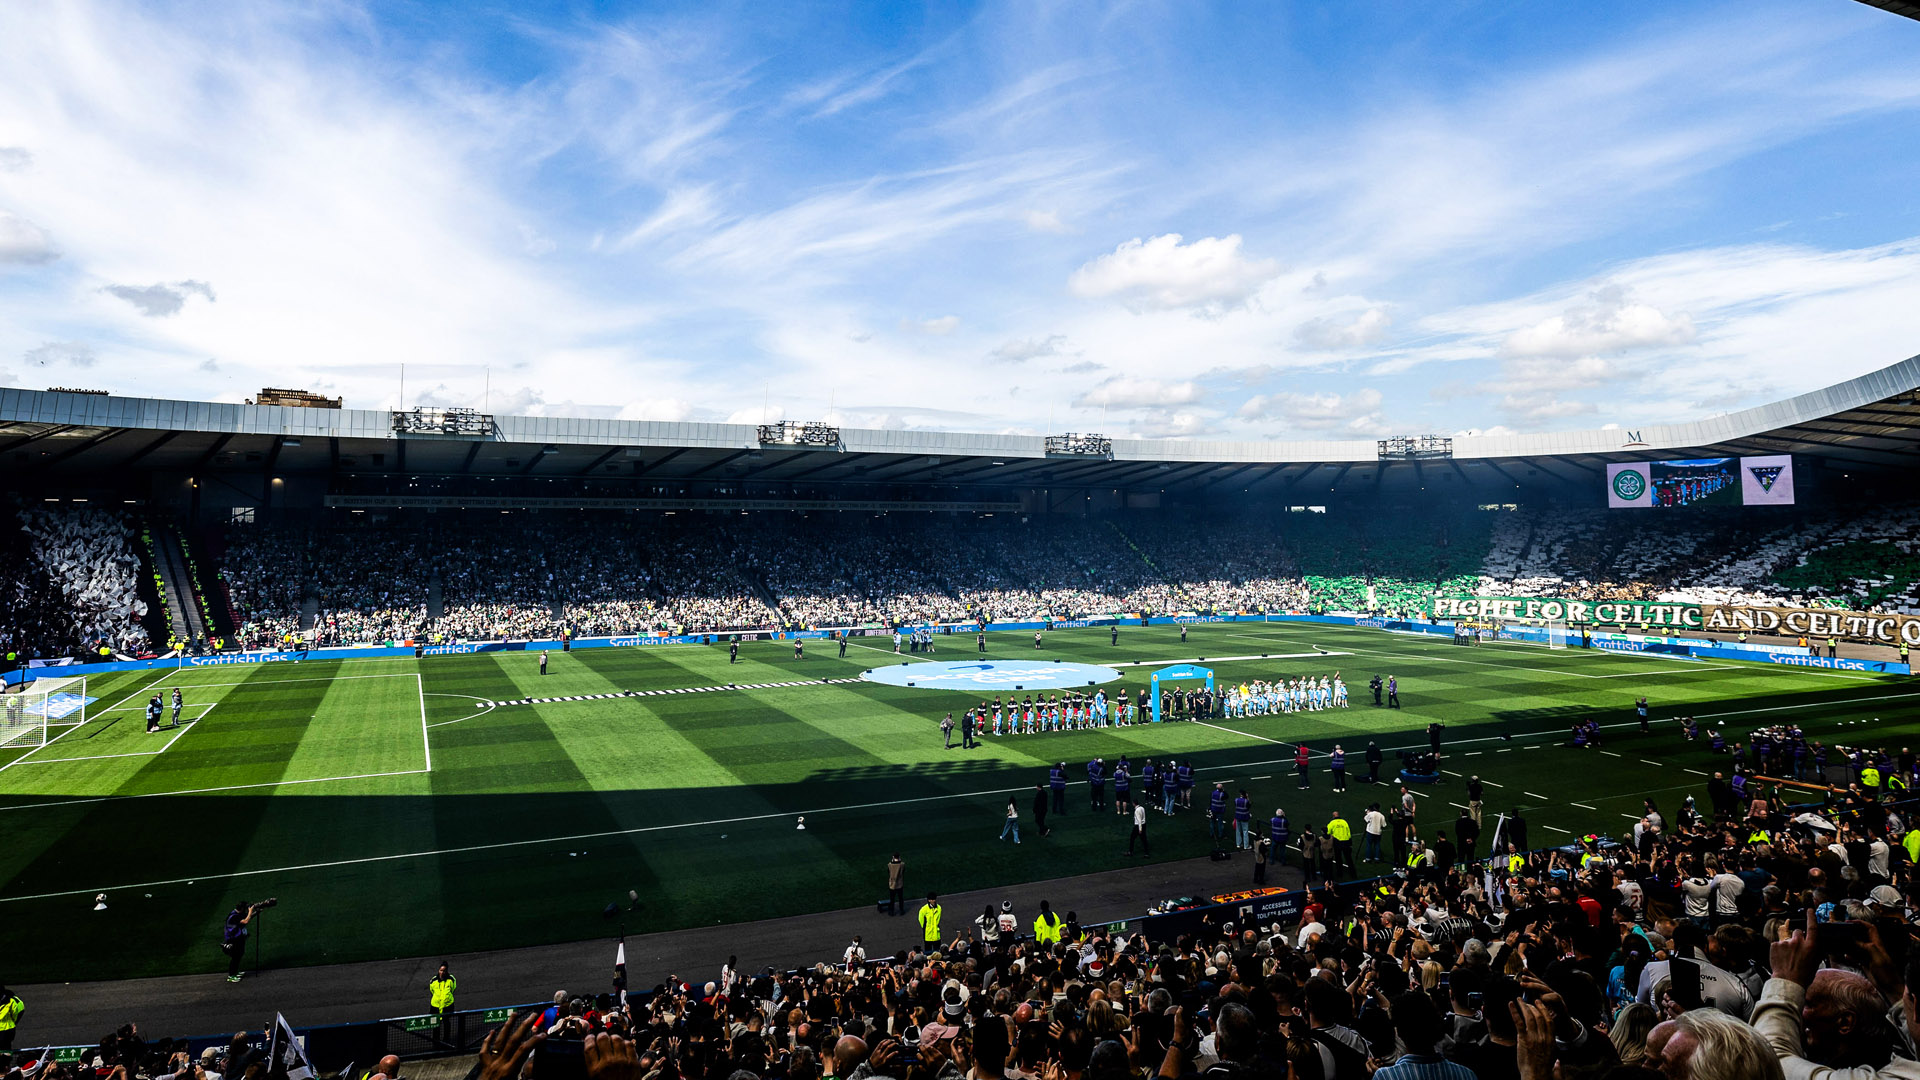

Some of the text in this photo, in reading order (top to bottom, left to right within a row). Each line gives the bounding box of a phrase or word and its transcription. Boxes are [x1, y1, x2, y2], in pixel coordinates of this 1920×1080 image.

[1627, 430, 1643, 443] M
[1355, 618, 1384, 628] Scottish
[1433, 597, 1523, 619] FIGHT
[1524, 601, 1589, 622] FOR
[1594, 604, 1701, 627] CELTIC
[1706, 607, 1781, 630] AND
[1786, 613, 1896, 642] CELTIC
[609, 637, 683, 647] Scottish Gas
[741, 633, 758, 641] CELTIC
[423, 644, 473, 655] cottish
[1592, 637, 1639, 651] Scottish
[1756, 645, 1797, 655] BARCLAYS
[190, 652, 288, 666] Scottish Gas
[1769, 653, 1865, 671] Scottish Gas
[1261, 899, 1292, 911] ACCESSIBLE
[1281, 907, 1298, 916] KIOSK
